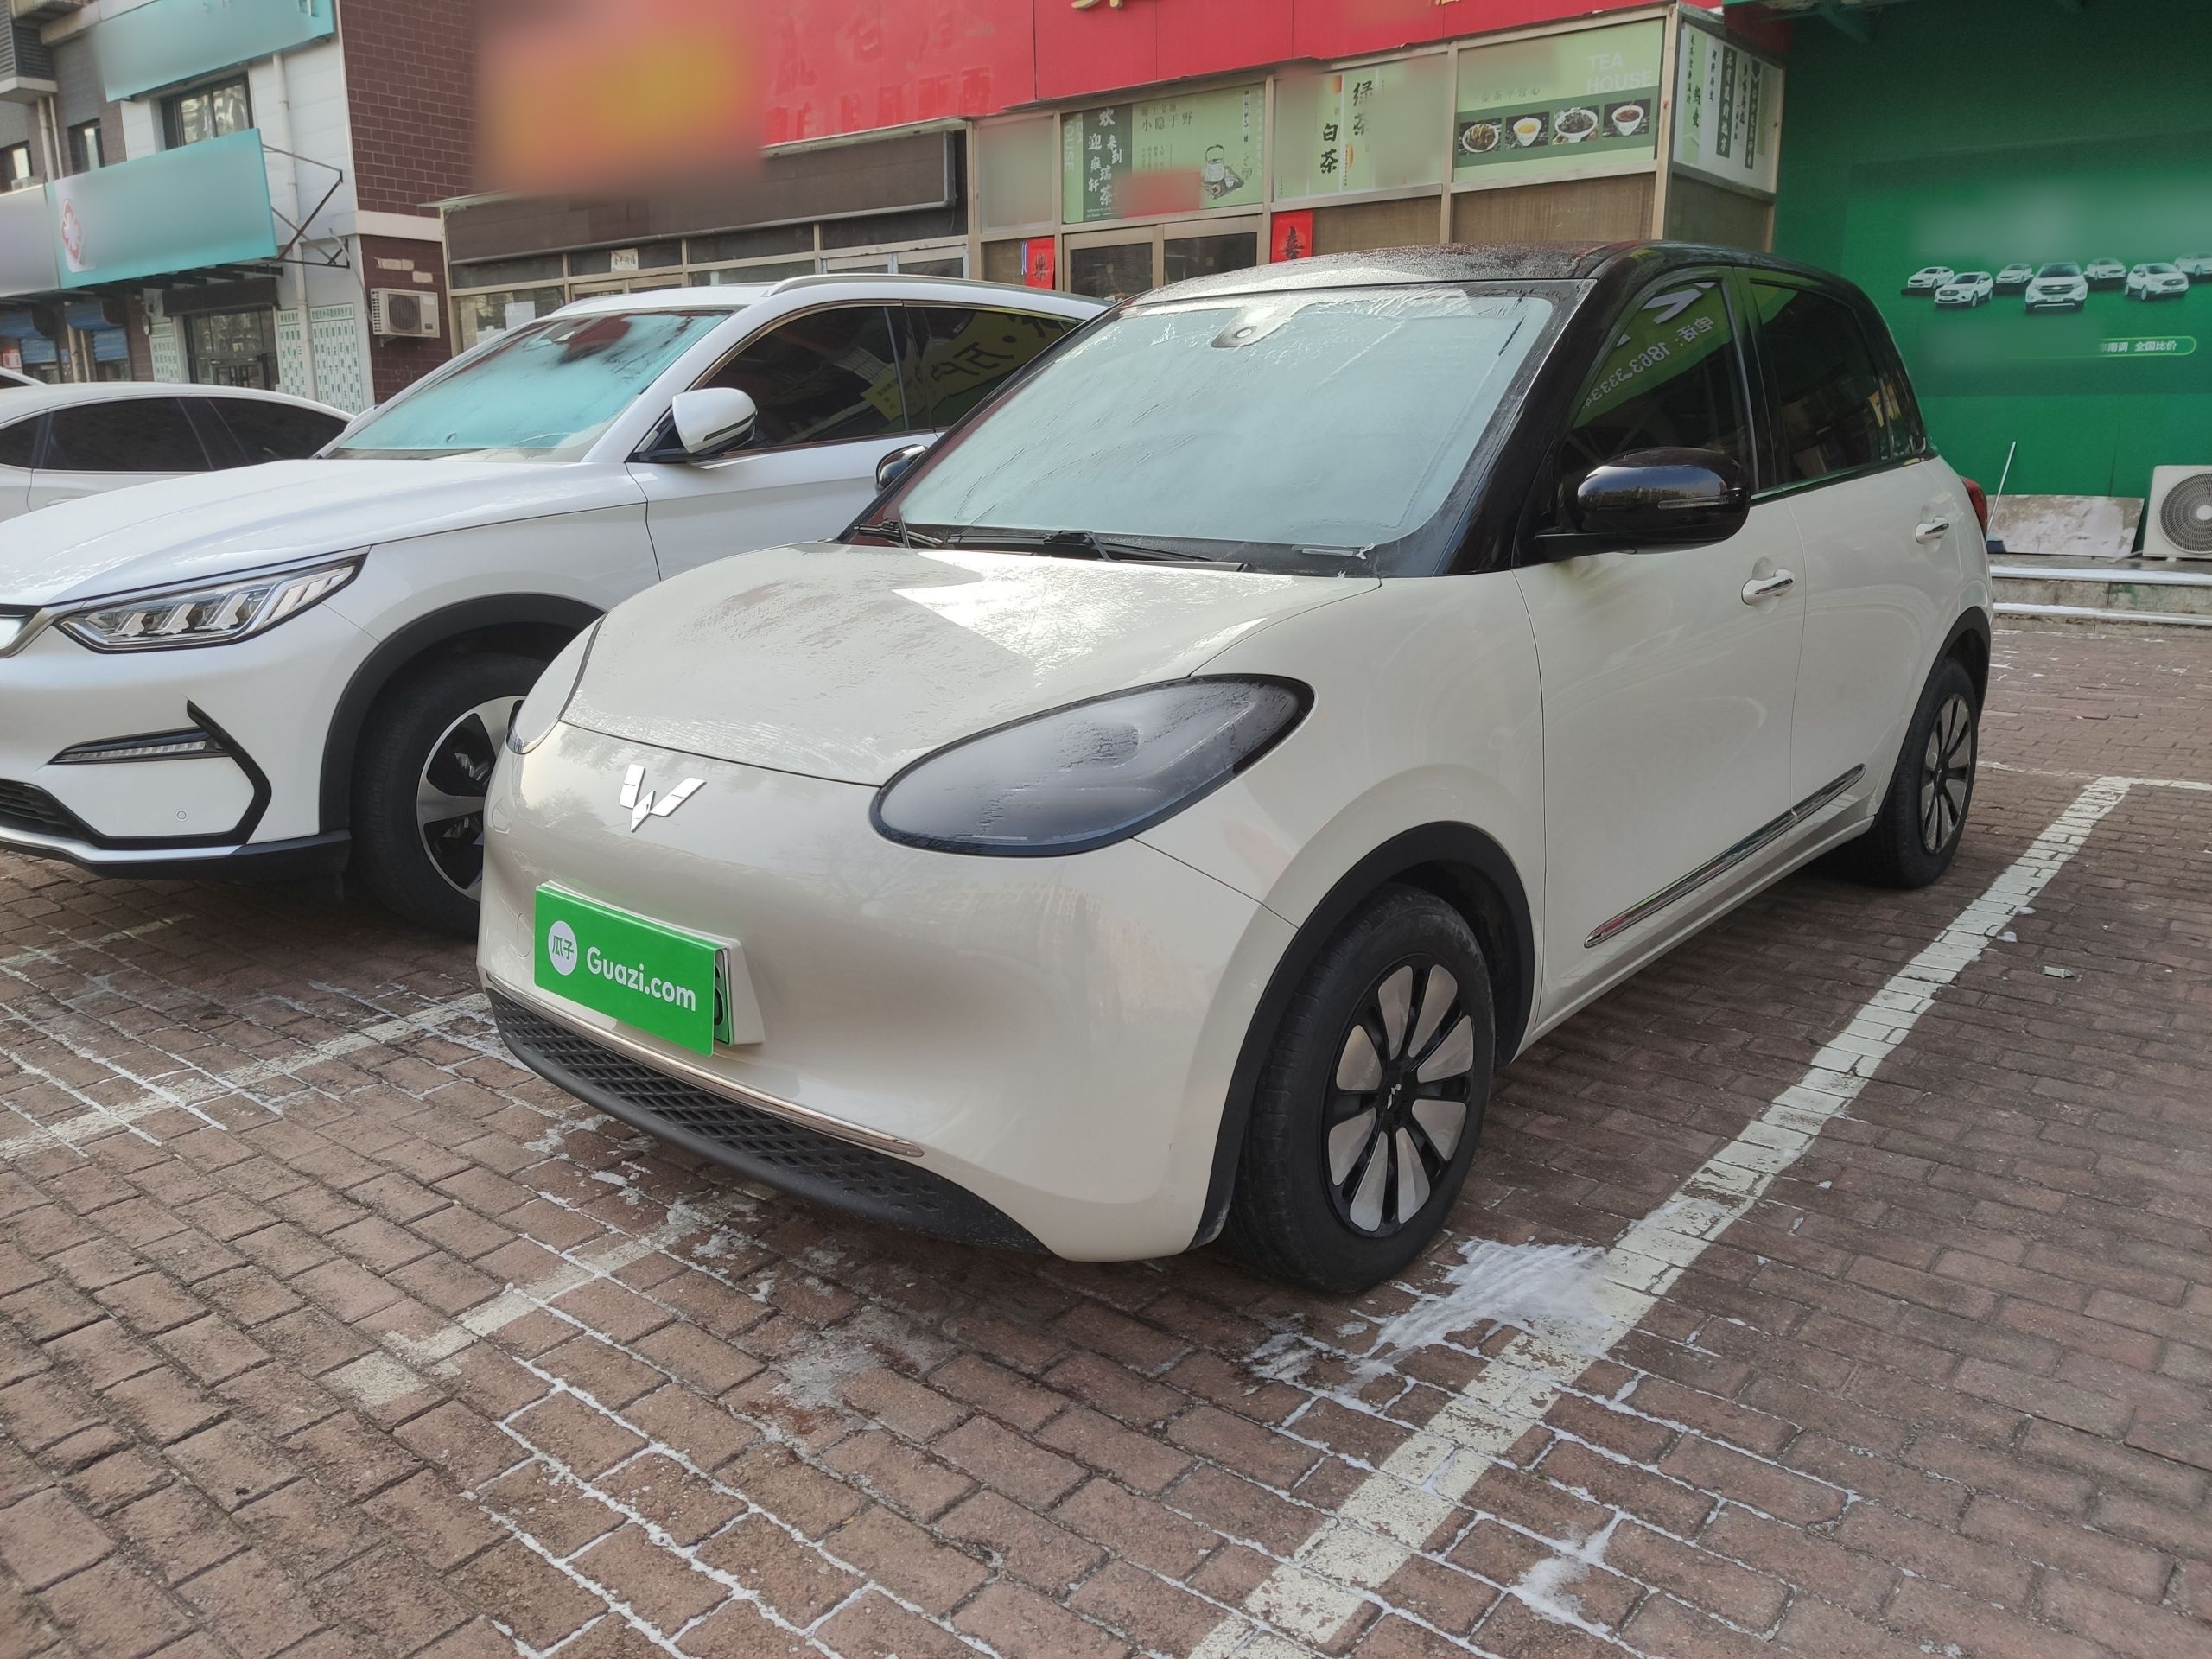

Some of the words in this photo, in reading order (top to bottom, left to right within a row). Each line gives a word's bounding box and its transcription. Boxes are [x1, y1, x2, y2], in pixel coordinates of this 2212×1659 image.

[1587, 52, 1624, 71] TEA
[1586, 69, 1653, 94] HOUSE
[1064, 119, 1075, 172] OUSE
[1319, 122, 1338, 175] 白茶
[2134, 340, 2177, 352] 全国比价
[551, 934, 575, 961] 瓜子
[586, 945, 697, 1012] Guazi.com
